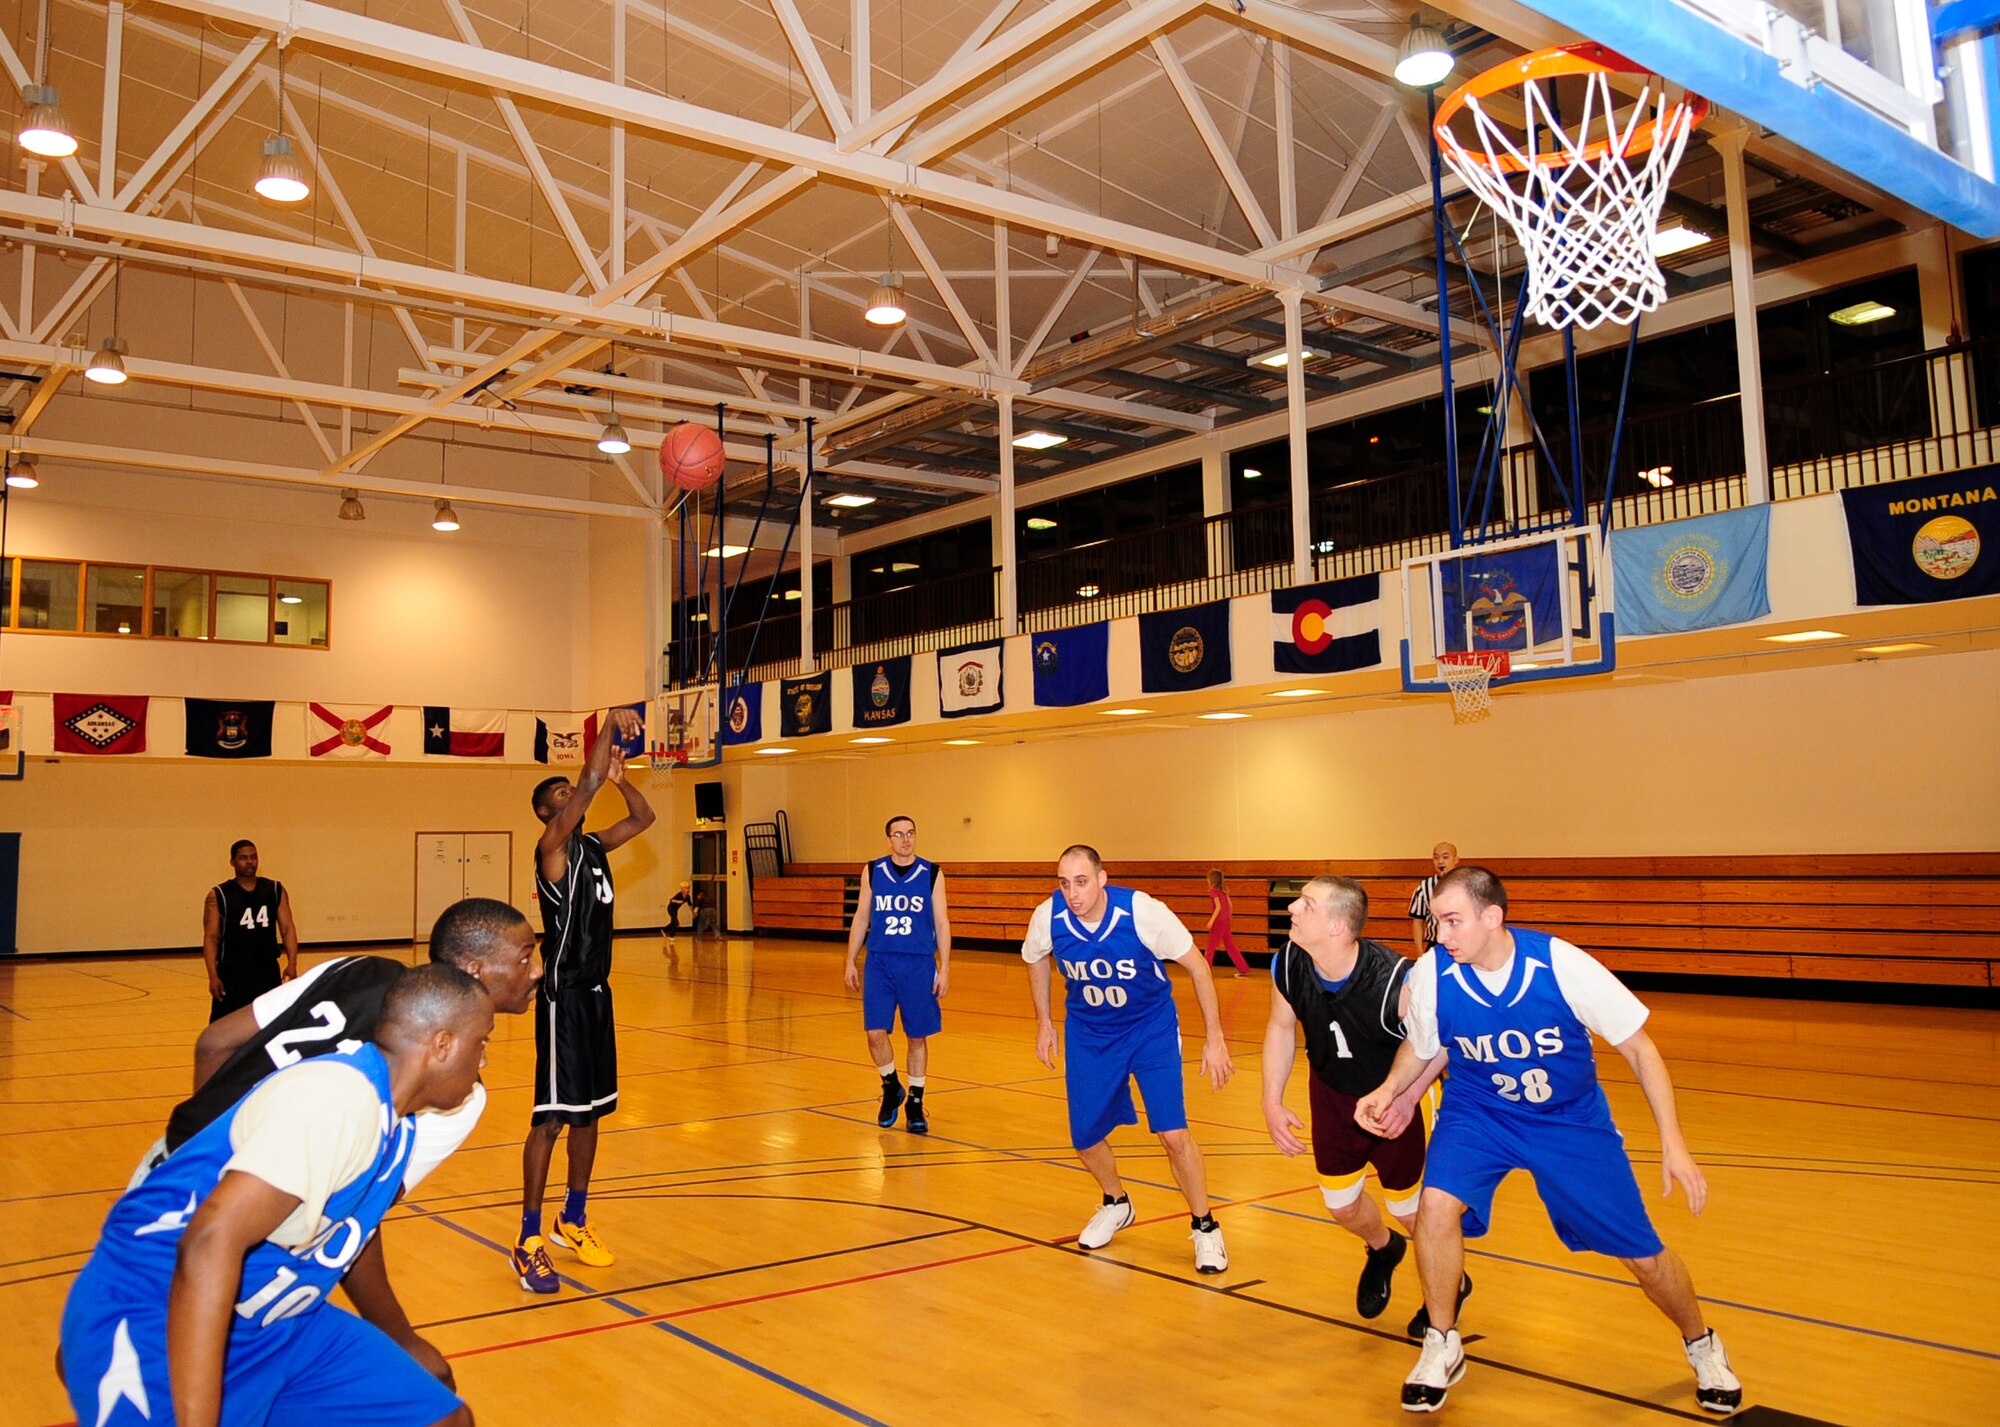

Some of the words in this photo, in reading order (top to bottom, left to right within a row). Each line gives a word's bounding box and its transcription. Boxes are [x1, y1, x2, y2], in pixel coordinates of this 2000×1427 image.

[1888, 486, 1998, 516] MONTANA
[864, 708, 896, 721] KANSAS
[557, 753, 574, 761] IOWA
[875, 895, 924, 912] MOS
[240, 905, 269, 929] 44
[885, 916, 912, 936] 23
[1062, 958, 1137, 981] MOS
[1083, 985, 1128, 1008] 00
[264, 1001, 364, 1070] 2
[1329, 1020, 1353, 1058] 1
[1453, 1026, 1564, 1063] MOS
[1491, 1068, 1553, 1104] 28
[234, 1265, 321, 1328] 10
